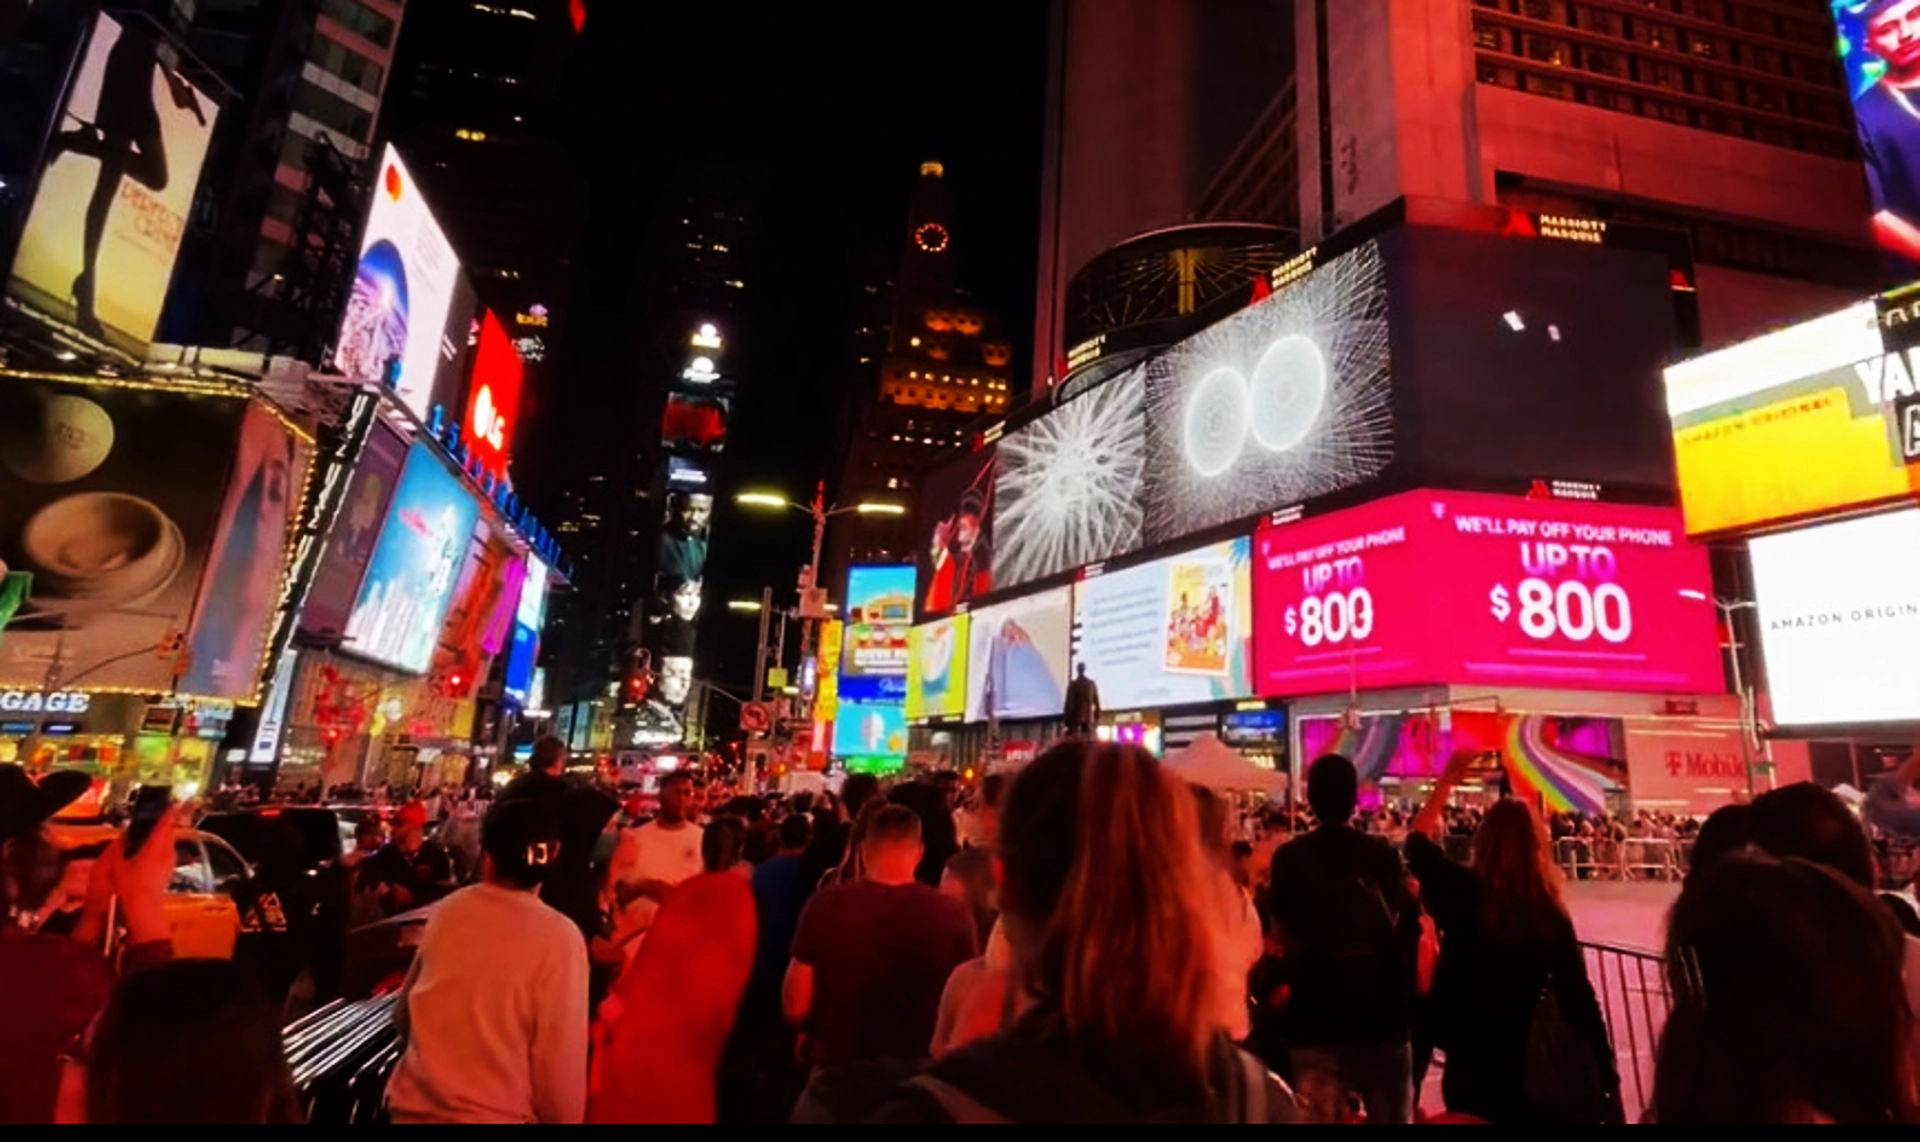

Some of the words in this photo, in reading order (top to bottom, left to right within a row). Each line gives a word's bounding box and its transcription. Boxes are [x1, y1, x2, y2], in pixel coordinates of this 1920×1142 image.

[1454, 514, 1504, 535] WE'LL
[1506, 518, 1537, 537] PAY
[1540, 521, 1571, 539] OFF
[1572, 525, 1616, 543] YOUR
[1618, 530, 1673, 547] PHONE
[1302, 562, 1332, 595] UP
[1333, 555, 1363, 590] TO
[1520, 541, 1568, 578] UP
[1569, 545, 1618, 581] TO
[1770, 613, 1843, 631] AMAZON
[1850, 603, 1919, 623] ORIGIN
